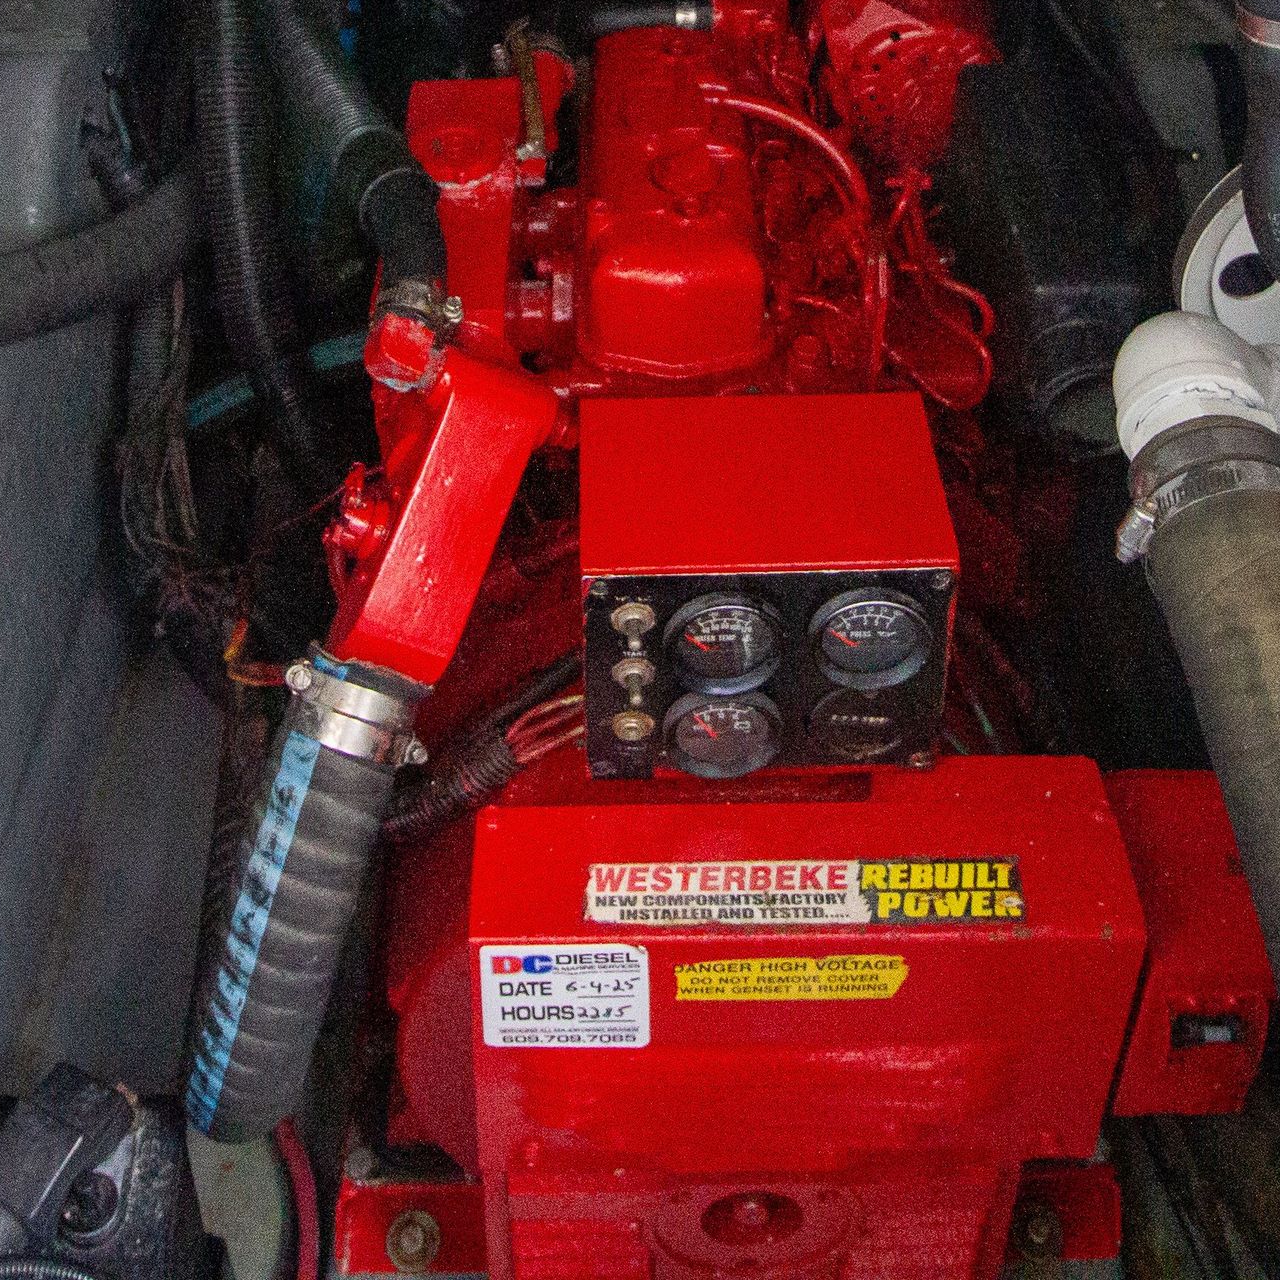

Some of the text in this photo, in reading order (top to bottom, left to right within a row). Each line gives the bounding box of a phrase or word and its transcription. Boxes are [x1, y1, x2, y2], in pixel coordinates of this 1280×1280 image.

[594, 864, 849, 892] WESTERBEKE
[861, 862, 1013, 890] REBUILT
[595, 892, 848, 907] NEW COMPONENTS FACTORY
[877, 890, 1022, 918] POWER
[619, 907, 713, 920] INSTALLED
[719, 908, 755, 920] AND
[491, 954, 554, 975] DC
[555, 952, 639, 965] DIESEL
[760, 962, 807, 972] HIGH
[816, 959, 900, 971] VOLTAGE
[499, 977, 641, 997] DATE 6-4-25
[690, 977, 713, 985] DO
[719, 976, 750, 985] NOT
[756, 975, 820, 984] REMOVE
[680, 983, 889, 995] WHEN GENSET IS RUNNING
[501, 1005, 575, 1021] HOURS
[502, 1034, 637, 1043] 609.709.7085
